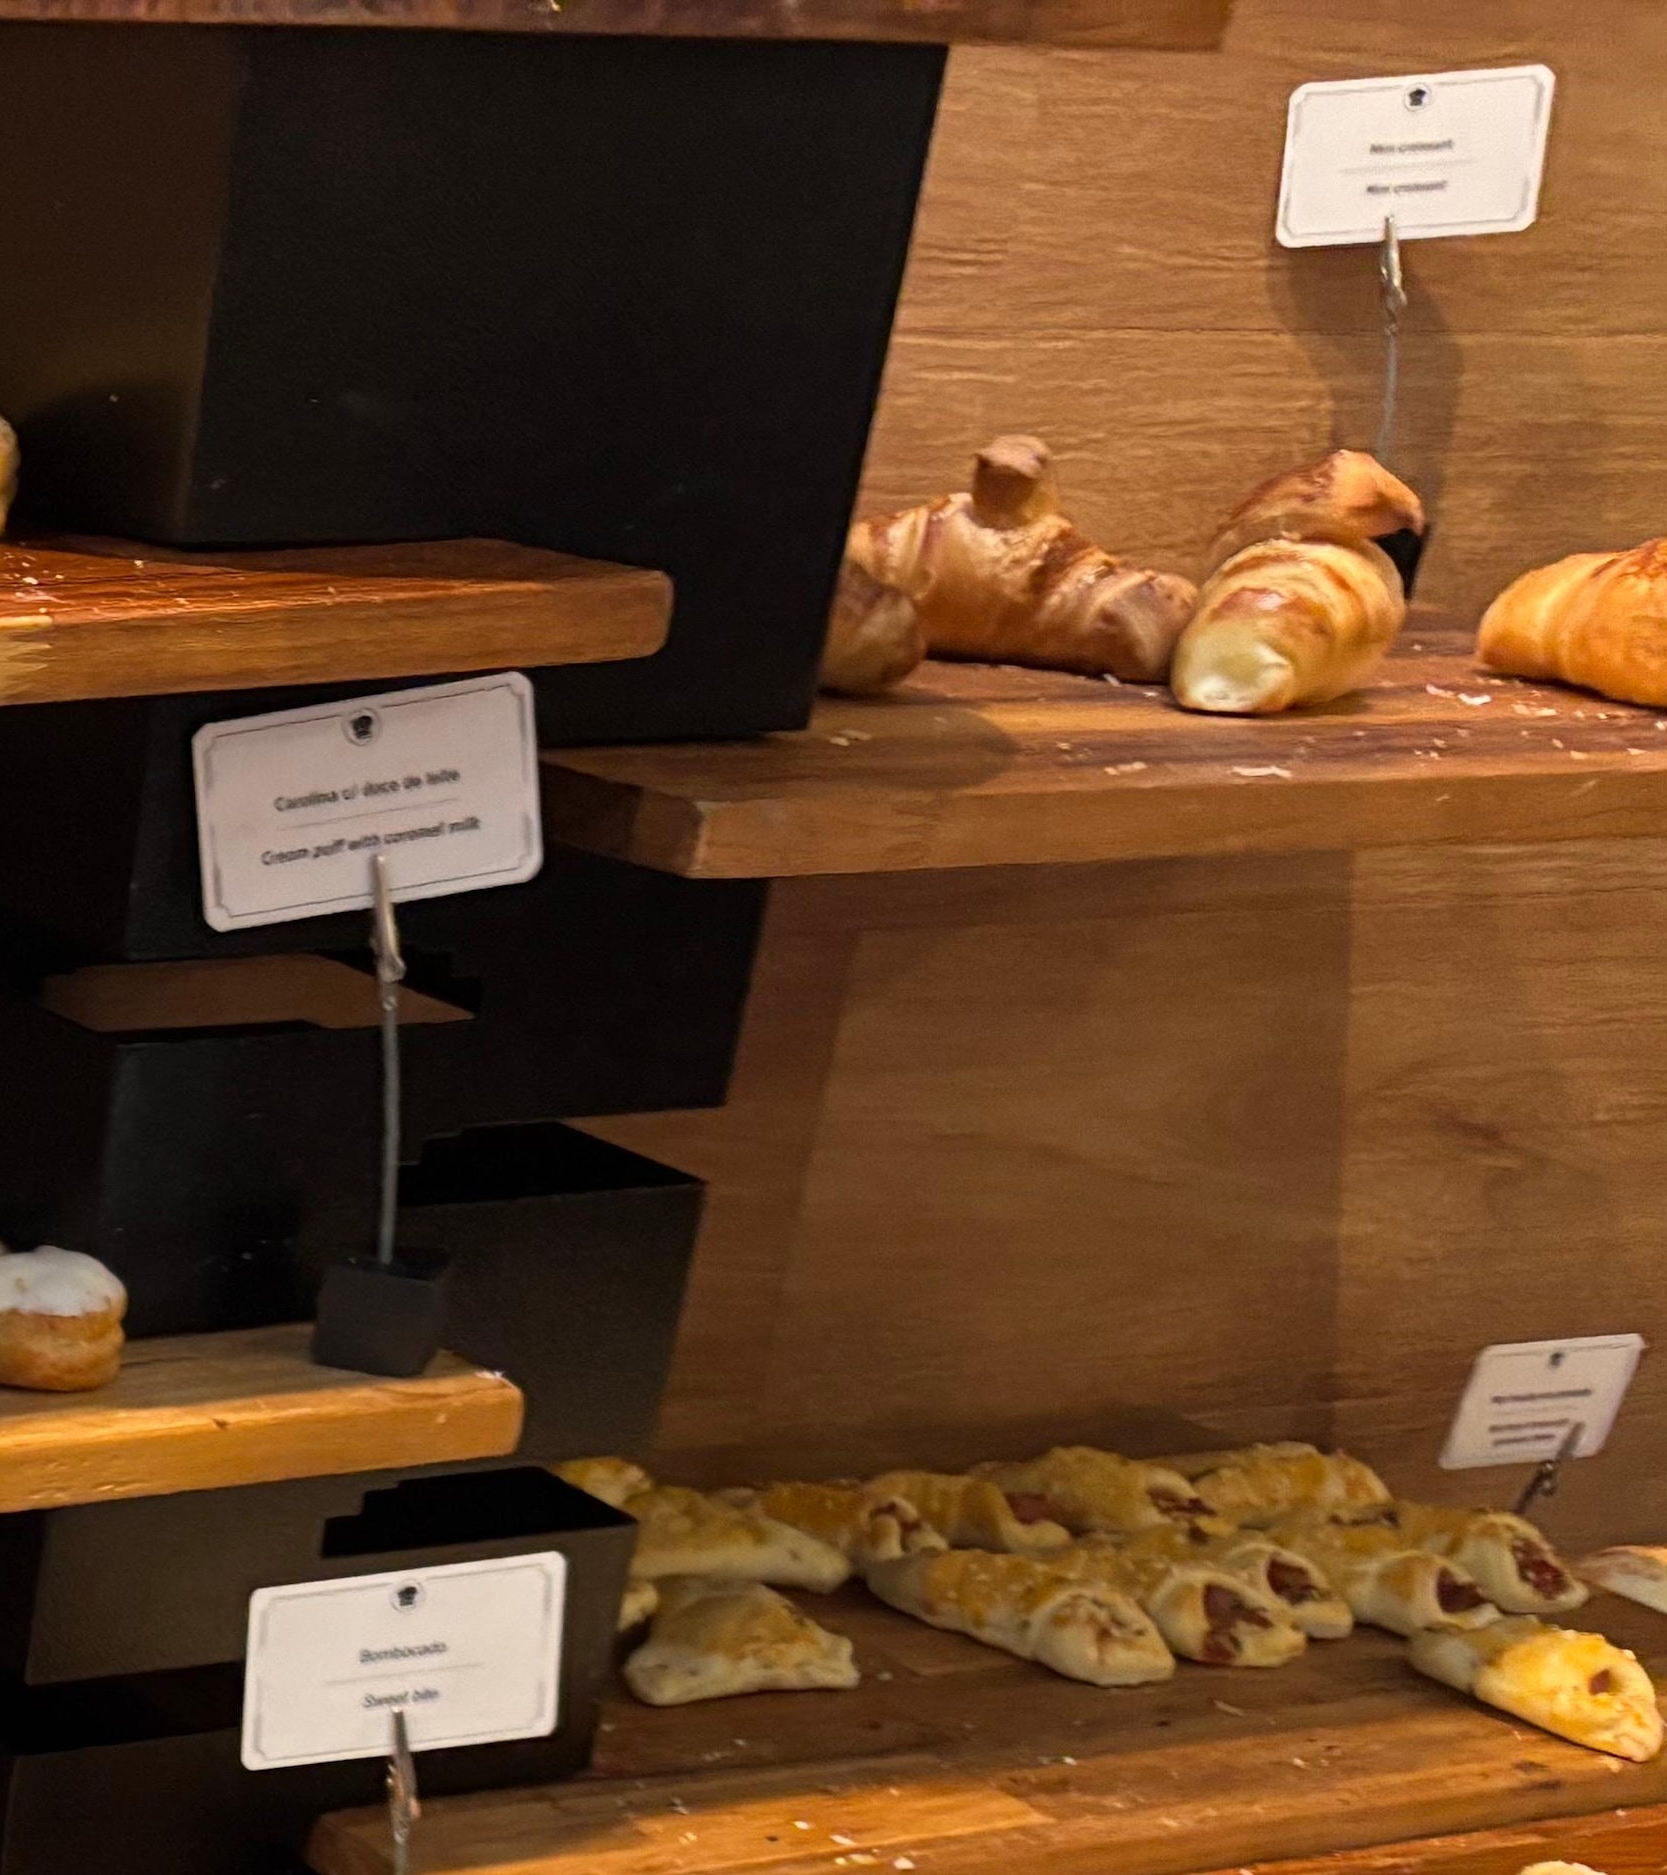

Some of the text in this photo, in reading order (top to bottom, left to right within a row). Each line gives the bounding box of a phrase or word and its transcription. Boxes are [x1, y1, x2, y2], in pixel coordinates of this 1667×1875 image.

[273, 790, 339, 812] Carolina
[362, 780, 400, 797] doce
[402, 774, 422, 790] de
[425, 769, 461, 786] leite
[261, 848, 309, 866] Cream
[312, 838, 345, 859] puff
[347, 834, 380, 851] with
[448, 815, 481, 834] milk
